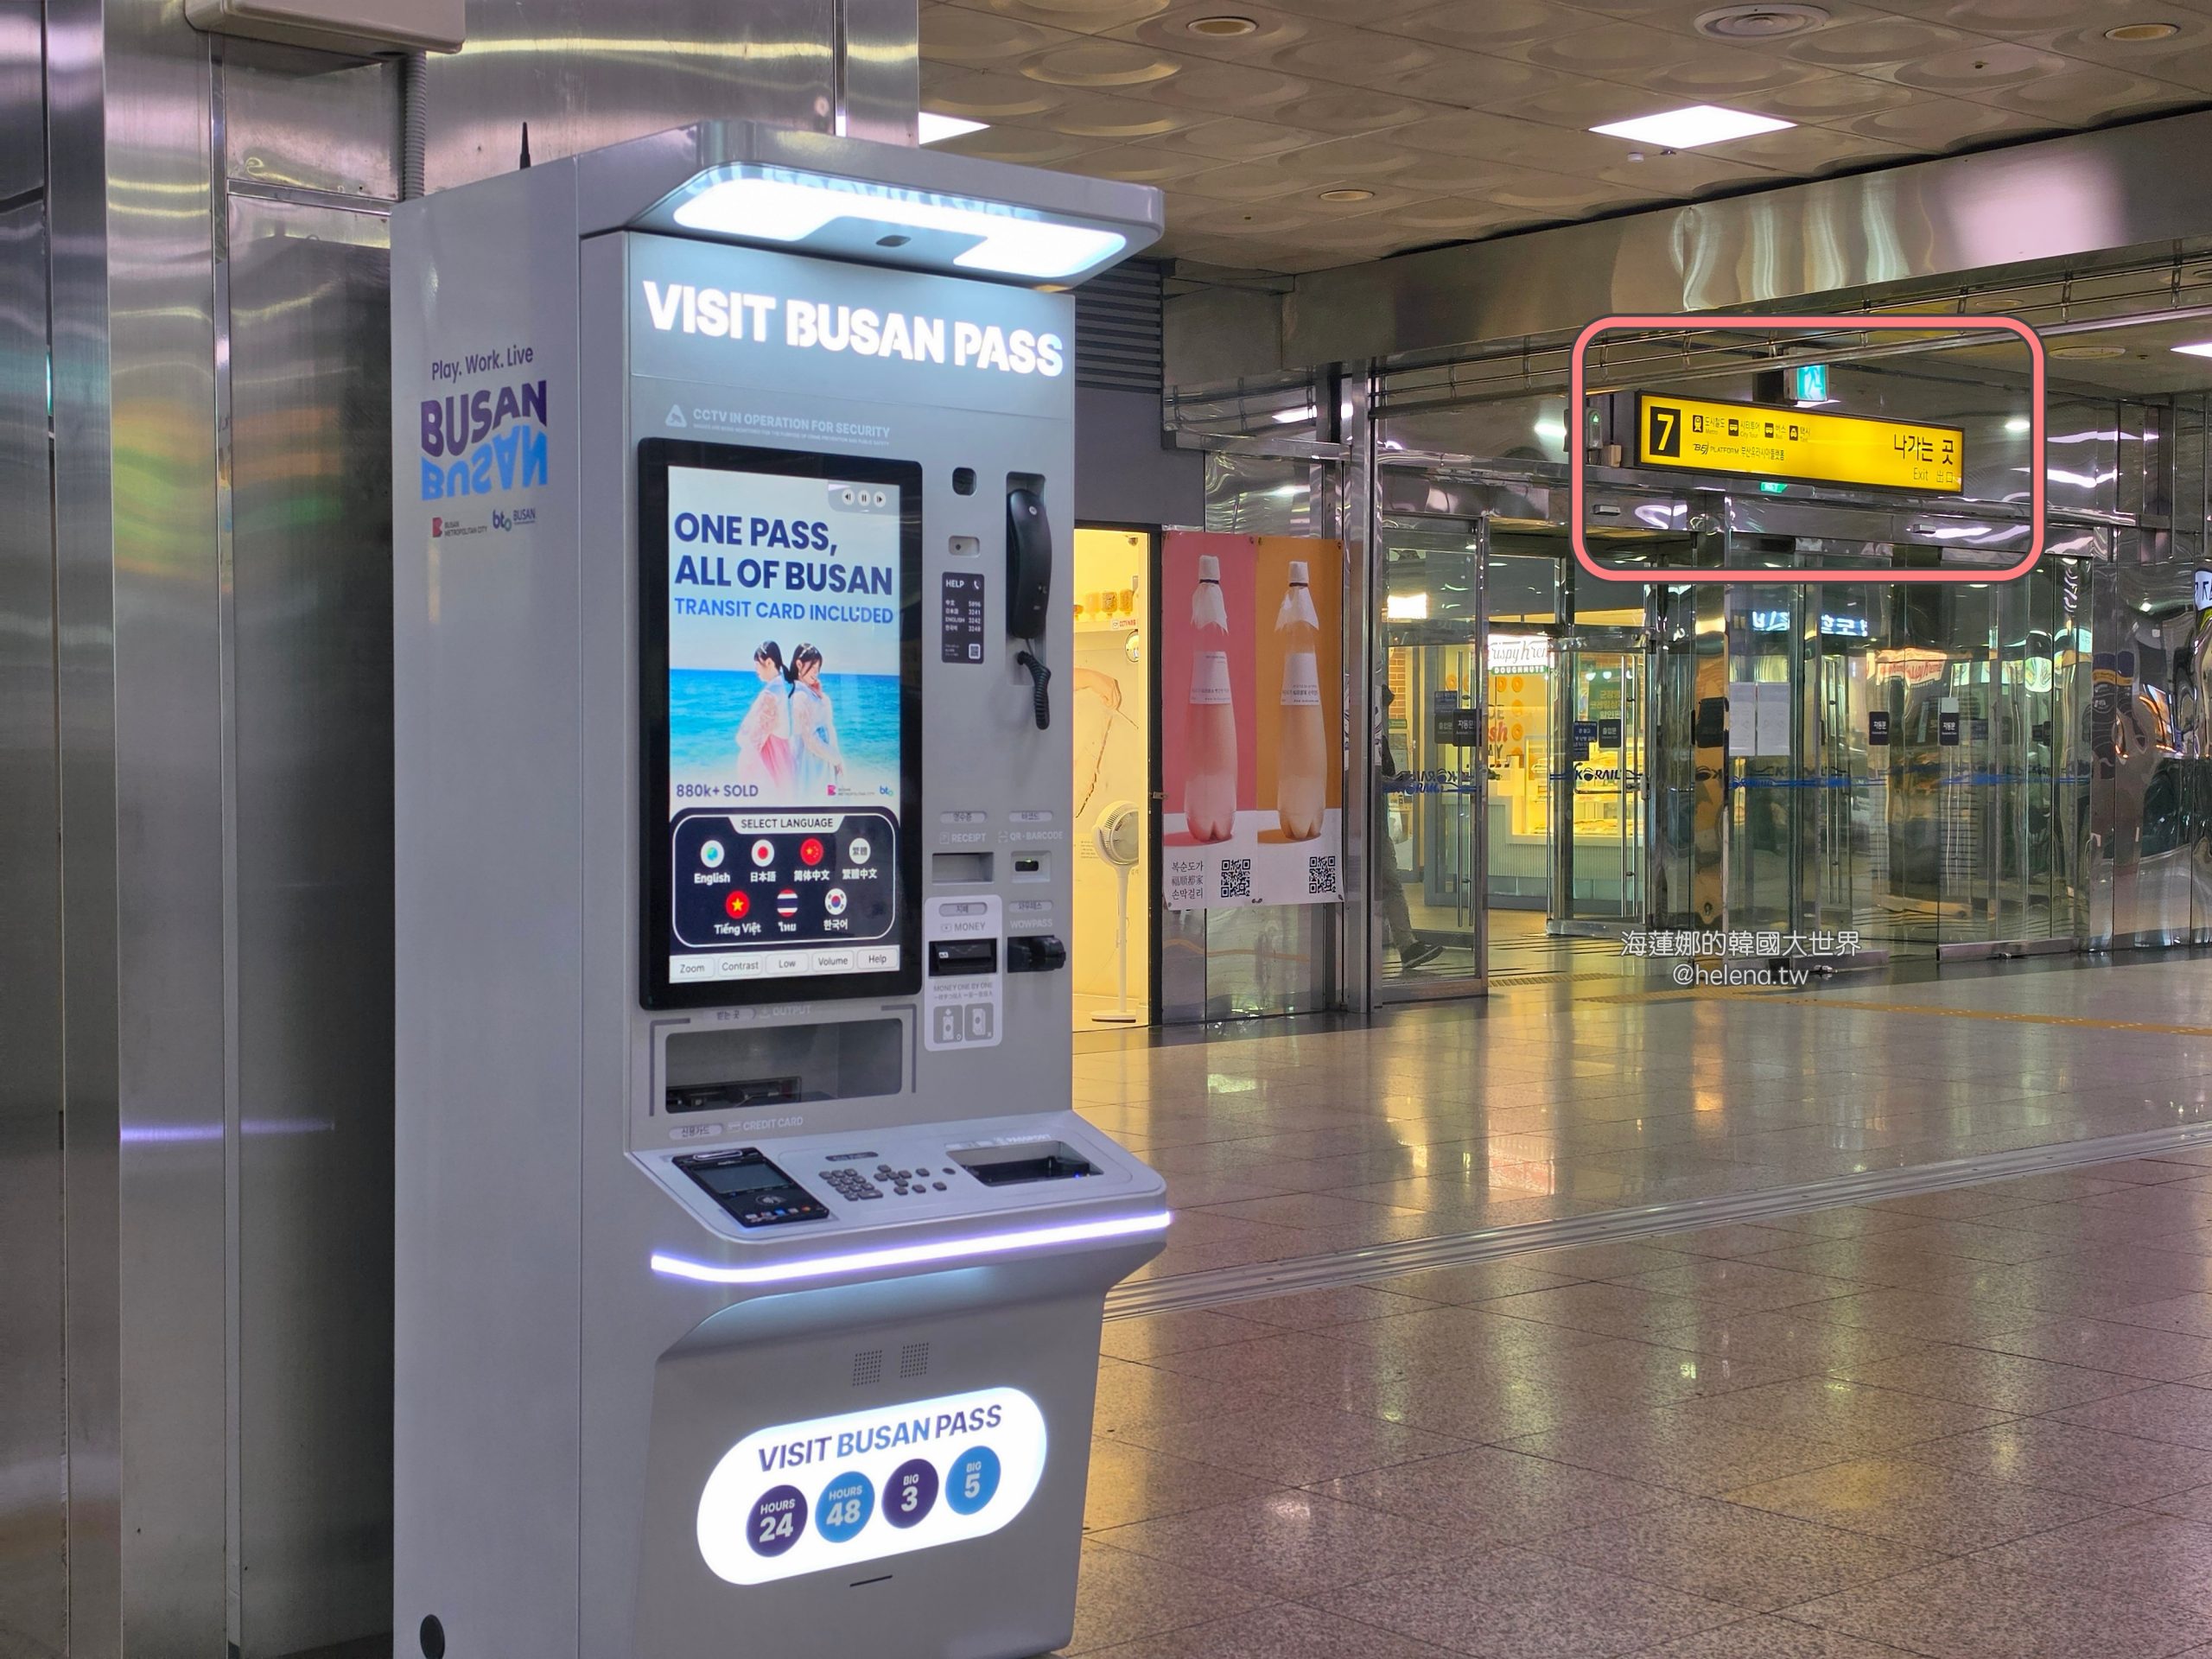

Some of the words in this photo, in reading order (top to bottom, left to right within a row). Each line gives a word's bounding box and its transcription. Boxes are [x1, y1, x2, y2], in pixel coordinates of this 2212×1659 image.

[643, 280, 777, 342] VISIT
[785, 299, 945, 364] BUSAN
[953, 321, 1065, 377] PASS
[433, 359, 462, 383] Play.
[465, 349, 504, 374] Work.
[507, 344, 533, 367] Live
[421, 379, 548, 457] BUSAN
[693, 409, 727, 423] CCTV
[729, 411, 741, 423] IN
[743, 413, 810, 431] OPERATION
[811, 420, 834, 433] FOR
[836, 423, 891, 438] SECURITY
[1705, 416, 1726, 428] 도시철도
[1775, 424, 1787, 433] 버스
[1657, 413, 1675, 451] 7
[1710, 446, 1739, 454] PLATFORM
[1894, 434, 1933, 462] 나가는
[1942, 439, 1954, 465] 곳
[1913, 467, 1929, 481] Exit
[1936, 470, 1953, 483] 出口
[512, 508, 537, 521] BUSAN
[674, 512, 742, 545] ONE
[750, 517, 837, 556] PASS,
[674, 555, 732, 587] ALL
[737, 558, 779, 589] OF
[785, 562, 893, 595] BUSAN
[674, 598, 752, 617] TRANSIT
[755, 602, 805, 620] CARD
[810, 606, 893, 624] INCLUDED
[1490, 640, 1520, 664] rispy
[1575, 767, 1622, 781] KORAIL
[676, 784, 721, 798] 880k+
[723, 784, 759, 797] SOLD
[741, 818, 778, 829] SELECT
[780, 818, 834, 828] LANGUAGE
[951, 833, 986, 843] RECEIPT
[1172, 861, 1204, 873] 복순도가
[694, 873, 731, 885] English
[750, 871, 776, 882] 日本語
[823, 918, 849, 931] 한국어
[954, 922, 986, 931] MONEY
[1010, 918, 1053, 929] WOWPASS
[721, 961, 759, 971] Contrast
[779, 959, 796, 969] Low
[818, 957, 849, 967] Volume
[868, 954, 887, 964] Help
[680, 963, 705, 973] Zoom
[772, 1005, 811, 1016] OUTPUT
[743, 1119, 776, 1131] CREDIT
[778, 1116, 804, 1128] CARD
[758, 1435, 832, 1472] VISIT
[836, 1417, 931, 1459] BUSAN
[934, 1404, 1002, 1439] PASS
[966, 1460, 982, 1473] BIG
[903, 1473, 919, 1486] BIG
[964, 1472, 981, 1499] 5
[829, 1485, 862, 1500] HOURS
[900, 1486, 918, 1512] 3
[760, 1498, 796, 1514] HOURS
[826, 1499, 861, 1528] 48
[759, 1512, 793, 1543] 24
